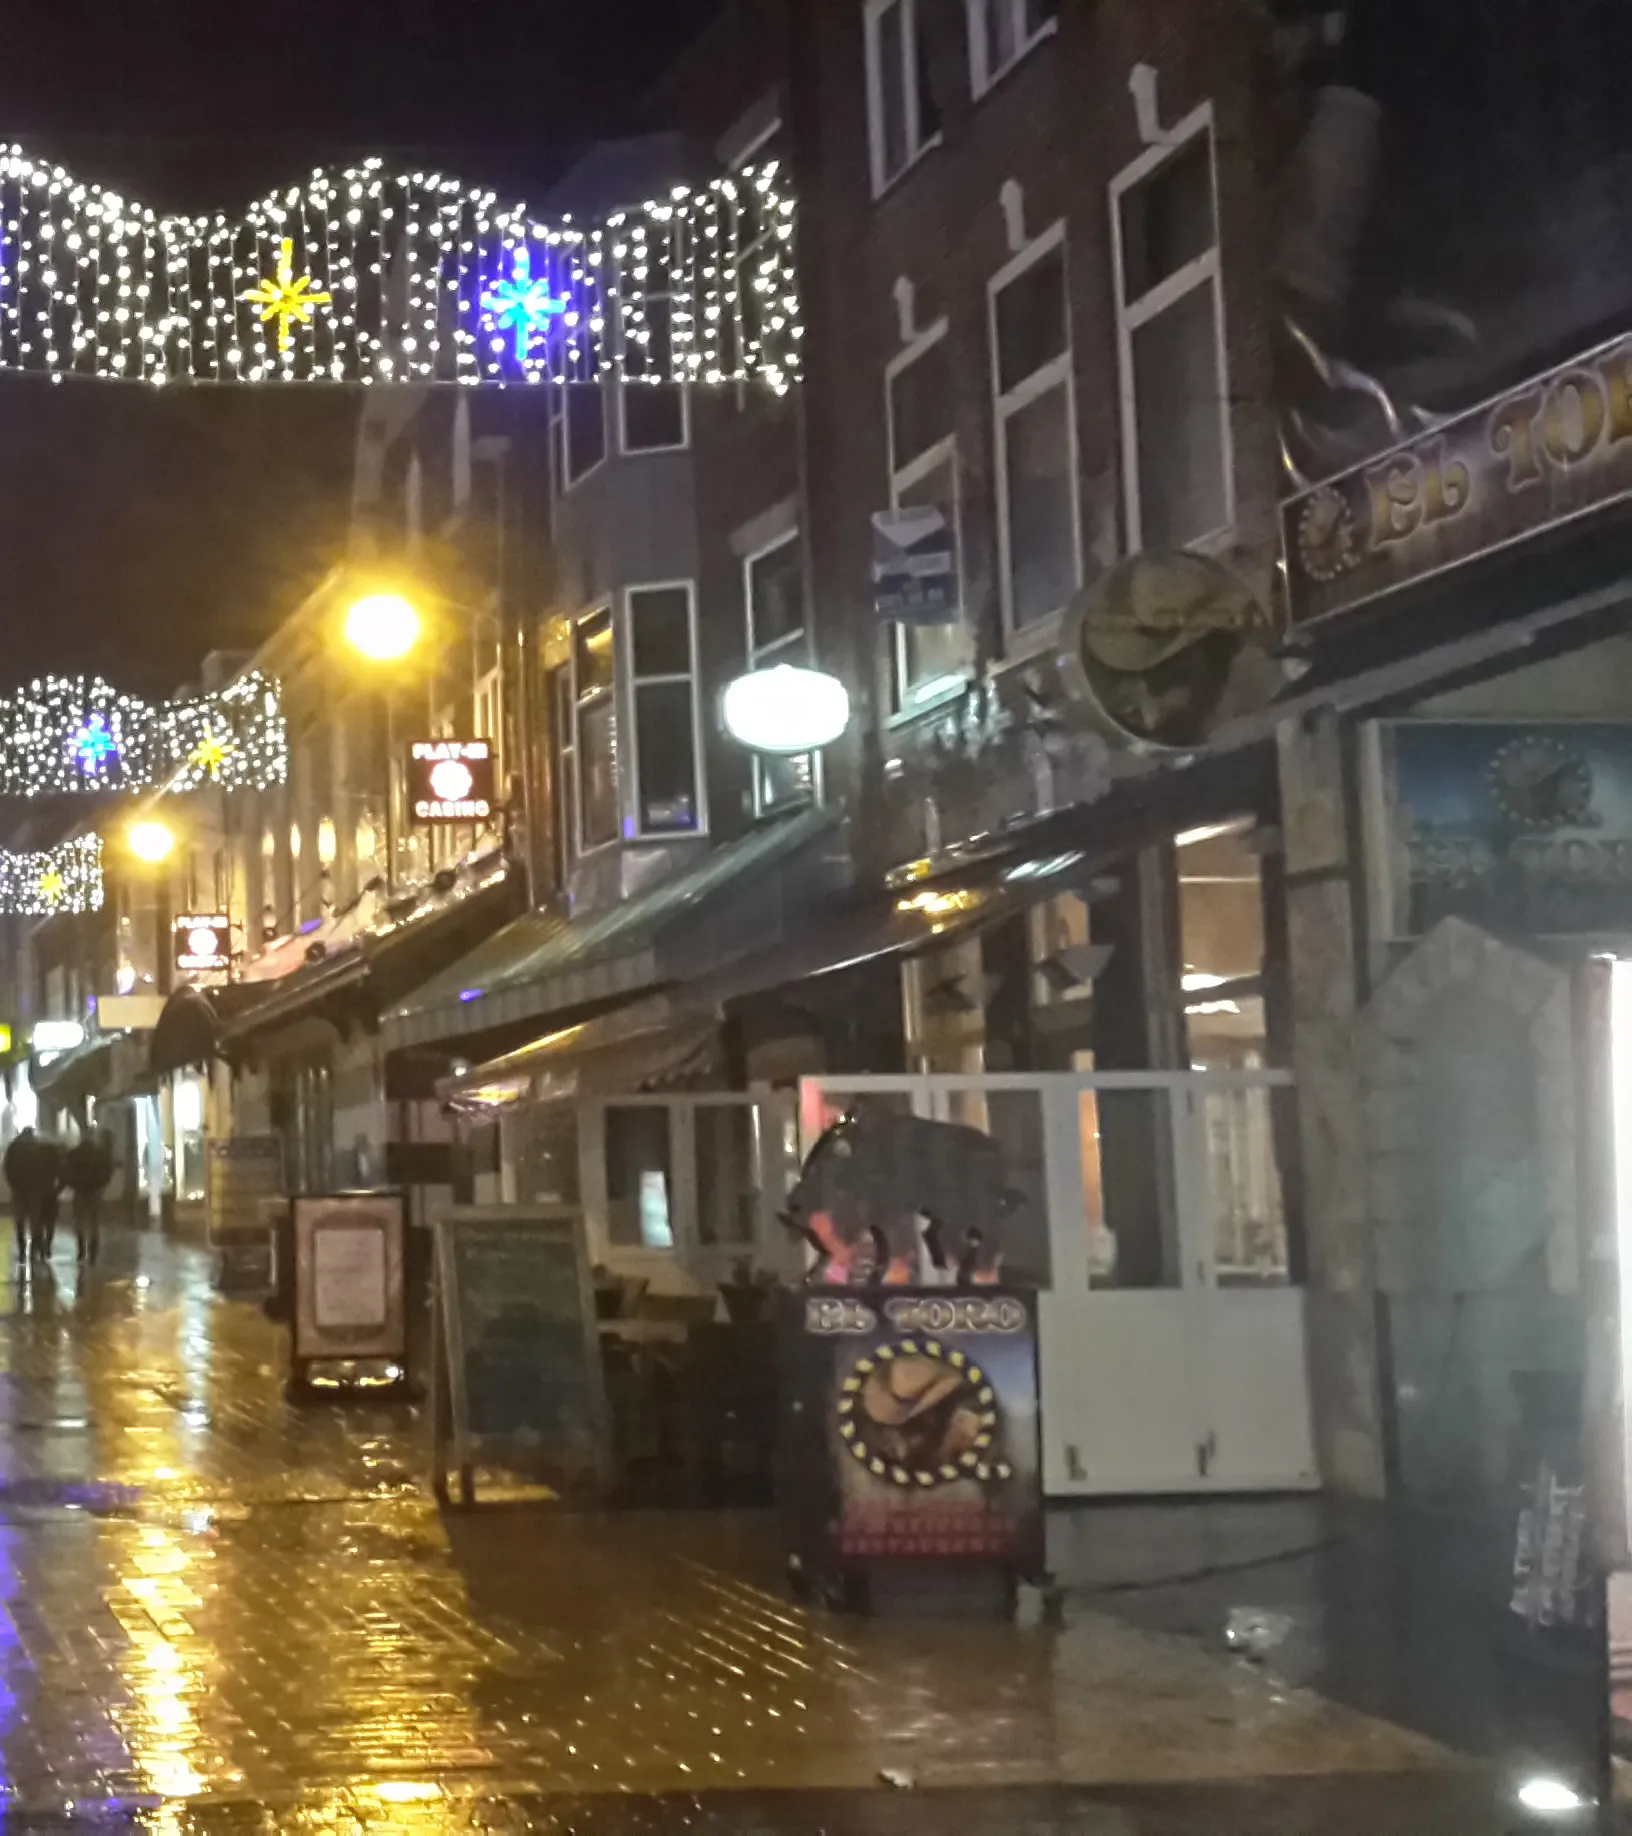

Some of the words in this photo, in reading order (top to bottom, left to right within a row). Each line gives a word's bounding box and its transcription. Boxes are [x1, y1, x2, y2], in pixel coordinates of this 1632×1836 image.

[1364, 436, 1470, 550] EL
[415, 800, 490, 818] CASINO
[805, 1298, 877, 1335] EL
[884, 1297, 1028, 1334] TORO
